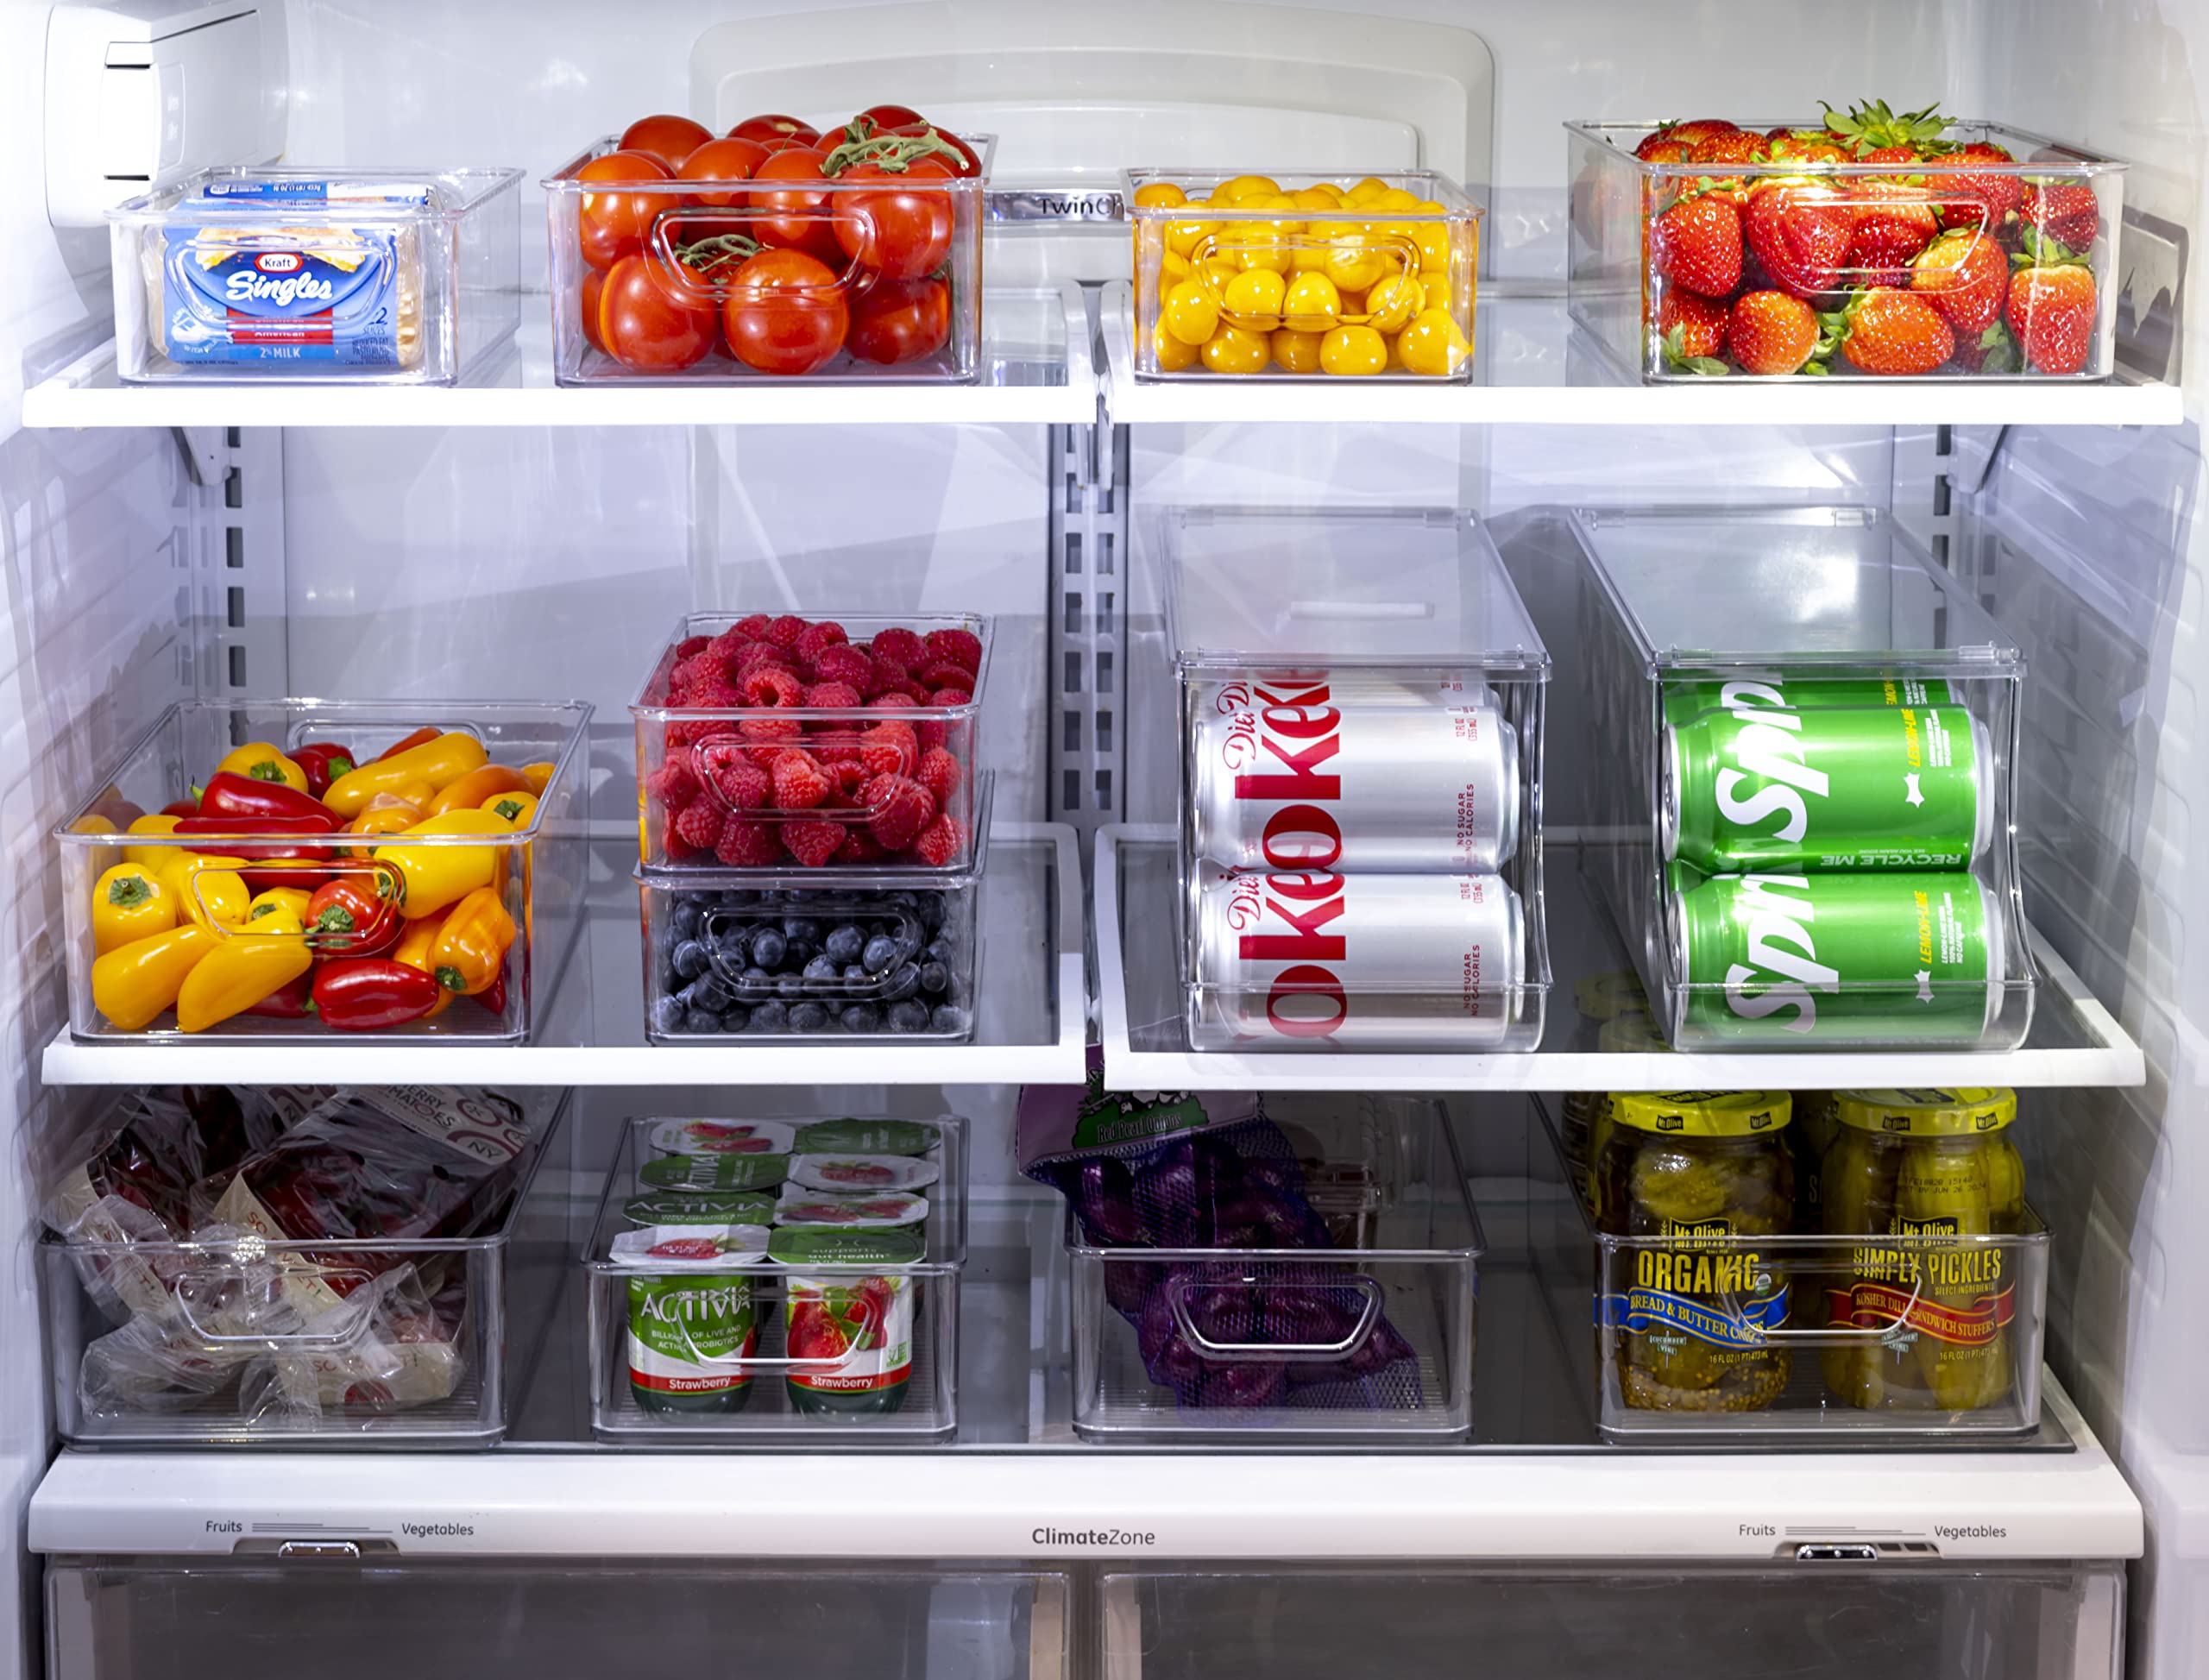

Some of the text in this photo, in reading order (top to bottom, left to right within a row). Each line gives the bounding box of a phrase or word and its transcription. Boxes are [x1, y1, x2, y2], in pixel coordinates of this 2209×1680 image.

[264, 257, 292, 267] Kraft
[225, 270, 333, 306] Singles
[273, 347, 301, 358] MILK
[1466, 783, 1475, 837] CALORIES
[1457, 792, 1466, 846] NO SUGAR
[1821, 853, 1962, 866] RECYCLE ME
[1463, 995, 1471, 1010] NO
[1470, 1004, 1479, 1016] NO
[403, 1085, 447, 1109] ERRY
[1098, 1113, 1182, 1143] Red Pearl Onions
[626, 1200, 770, 1213] ACTIVIA
[1693, 1224, 1726, 1249] Olive
[1923, 1222, 1954, 1248] Olive
[1638, 1249, 1759, 1294] ORGANIC
[1853, 1247, 2002, 1285] SIMPLY PICKLES
[1935, 1286, 1956, 1296] SELECT
[1630, 1294, 1665, 1312] BREAD
[1666, 1302, 1676, 1317] &
[1677, 1305, 1728, 1337] BUTTER
[1856, 1293, 1886, 1308] KOSHER
[1958, 1318, 1995, 1337] STUFFERS
[706, 1330, 724, 1338] LIVE
[726, 1324, 741, 1335] AND
[693, 1337, 739, 1350] ROBIOTICS
[1709, 1355, 1717, 1363] 16
[1718, 1354, 1725, 1363] FL
[669, 1375, 731, 1390] Strawberry
[810, 1375, 873, 1389] Strawberry
[205, 1520, 474, 1538] Fruits Vegetables
[1031, 1527, 1155, 1545] ClimateZone
[1739, 1524, 2007, 1538] Fruits Vegetables
